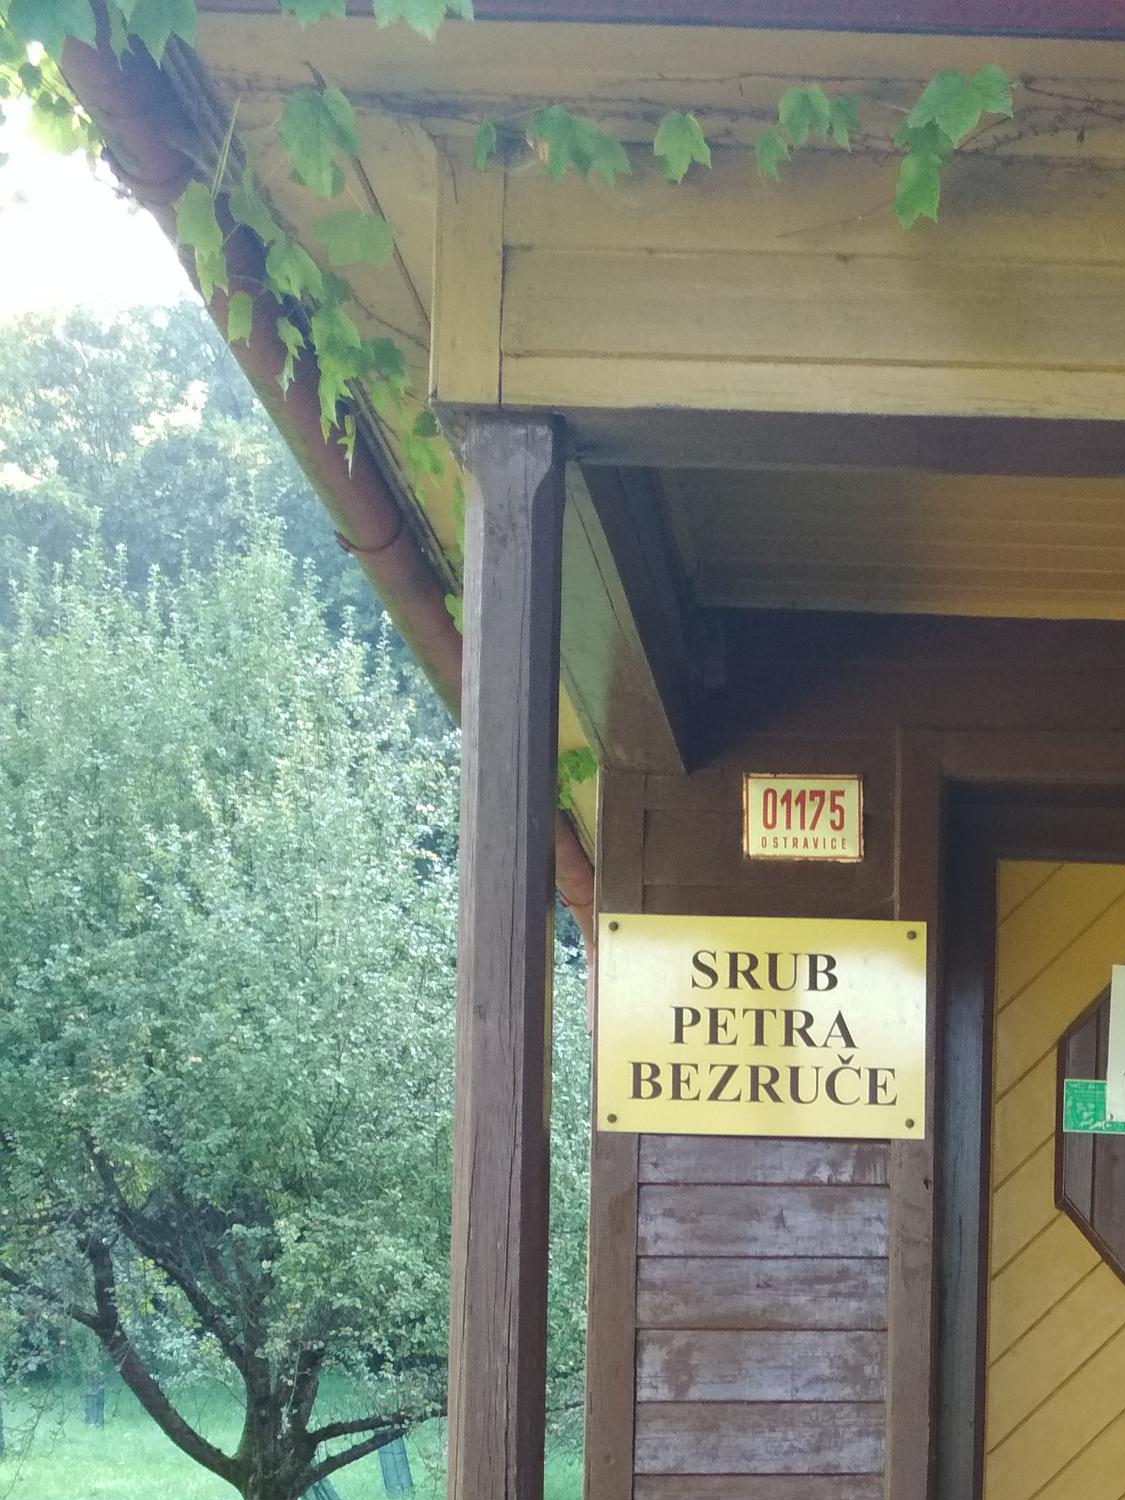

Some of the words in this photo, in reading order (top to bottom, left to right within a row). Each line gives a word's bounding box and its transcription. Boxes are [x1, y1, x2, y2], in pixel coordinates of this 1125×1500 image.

[762, 787, 845, 832] 01175
[761, 836, 847, 850] OSTRAVICE
[691, 949, 838, 992] SRUB
[670, 1005, 858, 1050] PETRA
[628, 1054, 898, 1107] BEZRUČE
